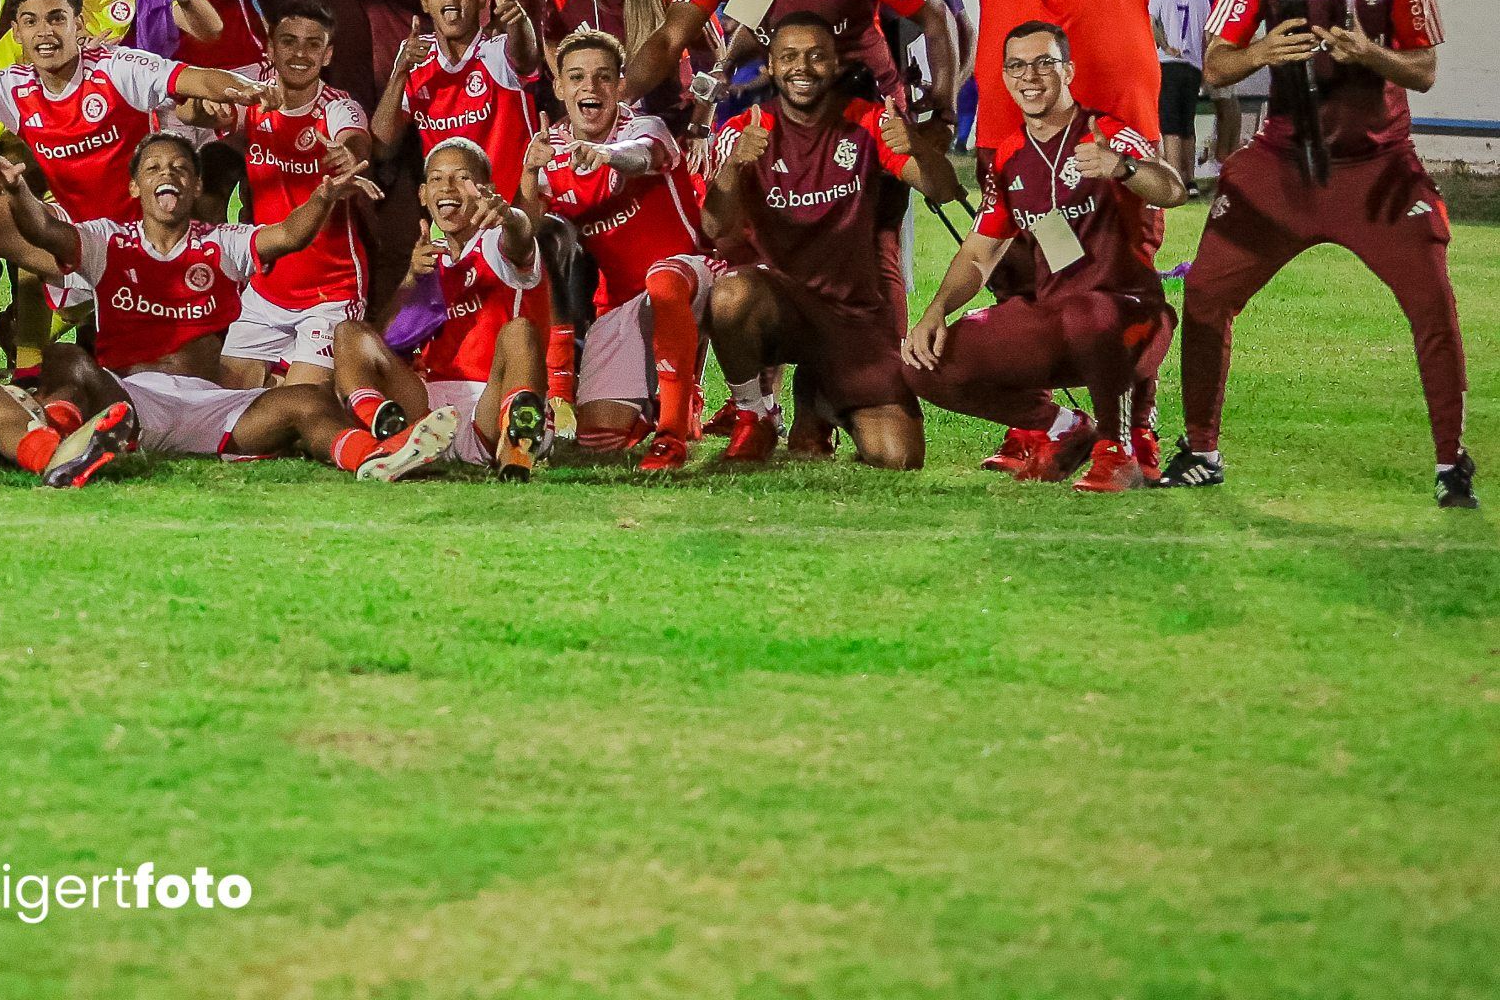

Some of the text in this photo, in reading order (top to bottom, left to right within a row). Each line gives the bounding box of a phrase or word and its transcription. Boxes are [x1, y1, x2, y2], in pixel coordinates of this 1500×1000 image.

[1176, 4, 1191, 41] 7
[116, 51, 150, 66] vero
[427, 102, 491, 130] banrisul
[42, 125, 120, 160] banrisul
[789, 175, 861, 207] banrisul
[136, 294, 217, 320] banrisul
[447, 294, 482, 320] risul
